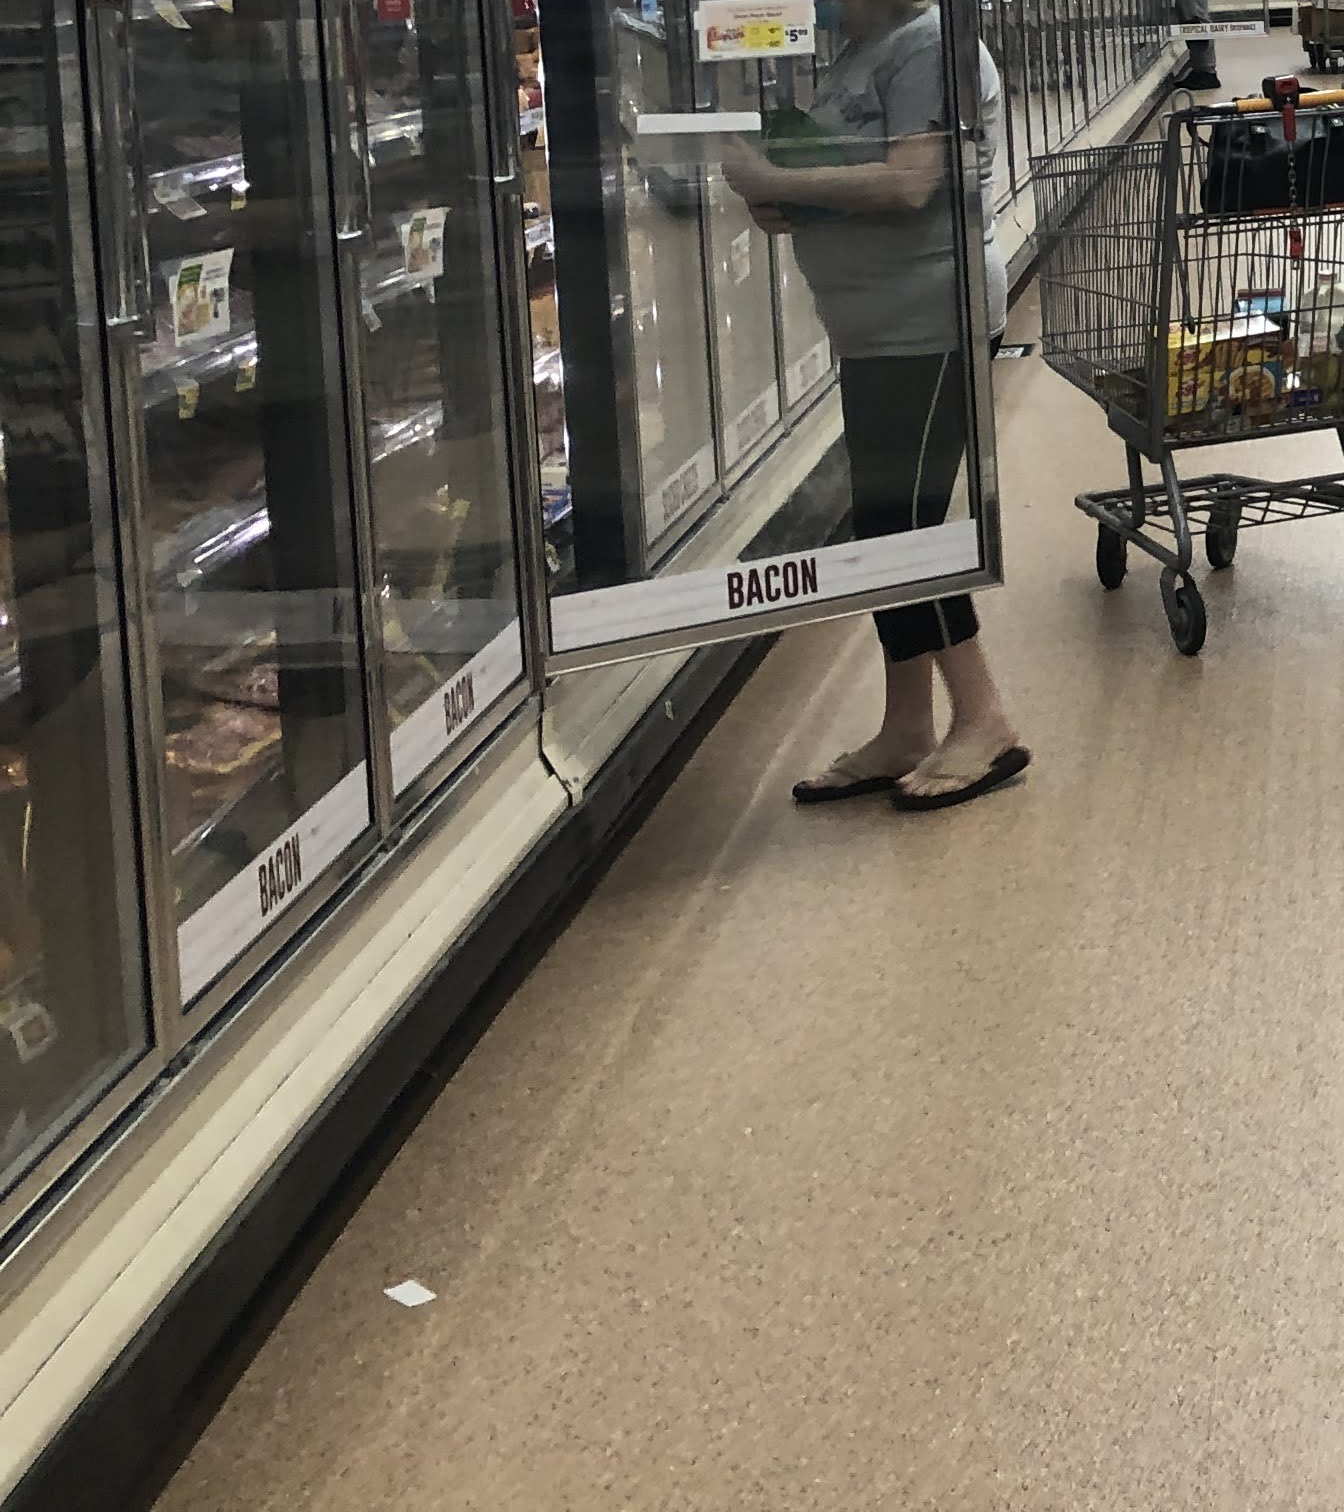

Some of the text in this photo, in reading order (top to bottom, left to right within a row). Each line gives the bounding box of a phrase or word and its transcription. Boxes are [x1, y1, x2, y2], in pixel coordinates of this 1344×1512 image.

[727, 557, 818, 610] BACON
[444, 671, 475, 736] BACON
[258, 833, 302, 917] BACON
